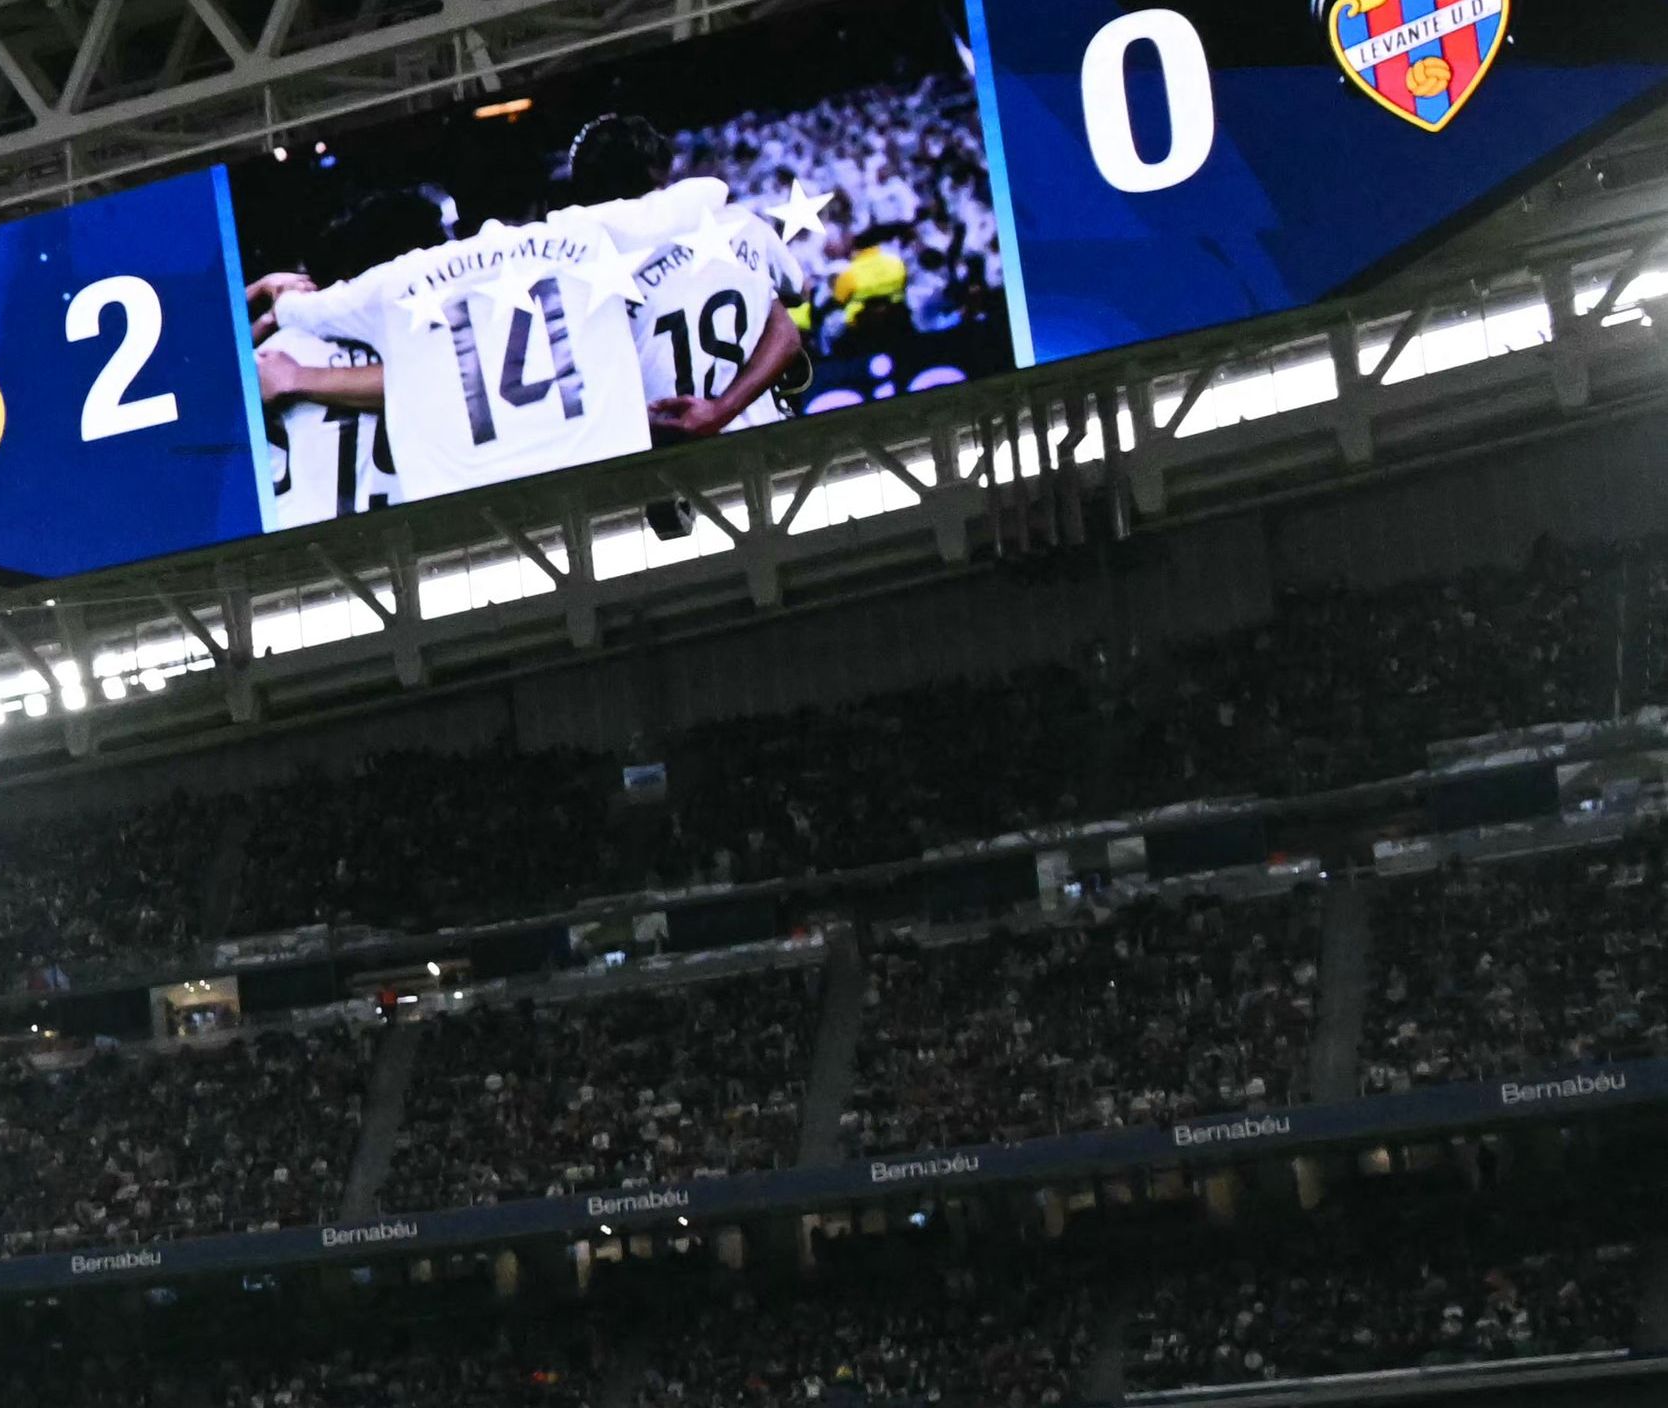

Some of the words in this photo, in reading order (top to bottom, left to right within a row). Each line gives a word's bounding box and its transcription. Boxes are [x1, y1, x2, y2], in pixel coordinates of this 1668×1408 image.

[1359, 16, 1440, 63] LEVANTE
[1081, 8, 1214, 193] 0
[65, 275, 178, 442] 2
[430, 277, 584, 446] 14
[653, 289, 748, 400] 18
[1501, 1069, 1626, 1105] Bernabéu
[1174, 1114, 1291, 1147] Bernabéu
[870, 1152, 980, 1182] Bernabéu
[588, 1187, 690, 1216] Bernabéu
[321, 1220, 419, 1247] Bernabéu
[70, 1249, 162, 1274] Bernabéu
